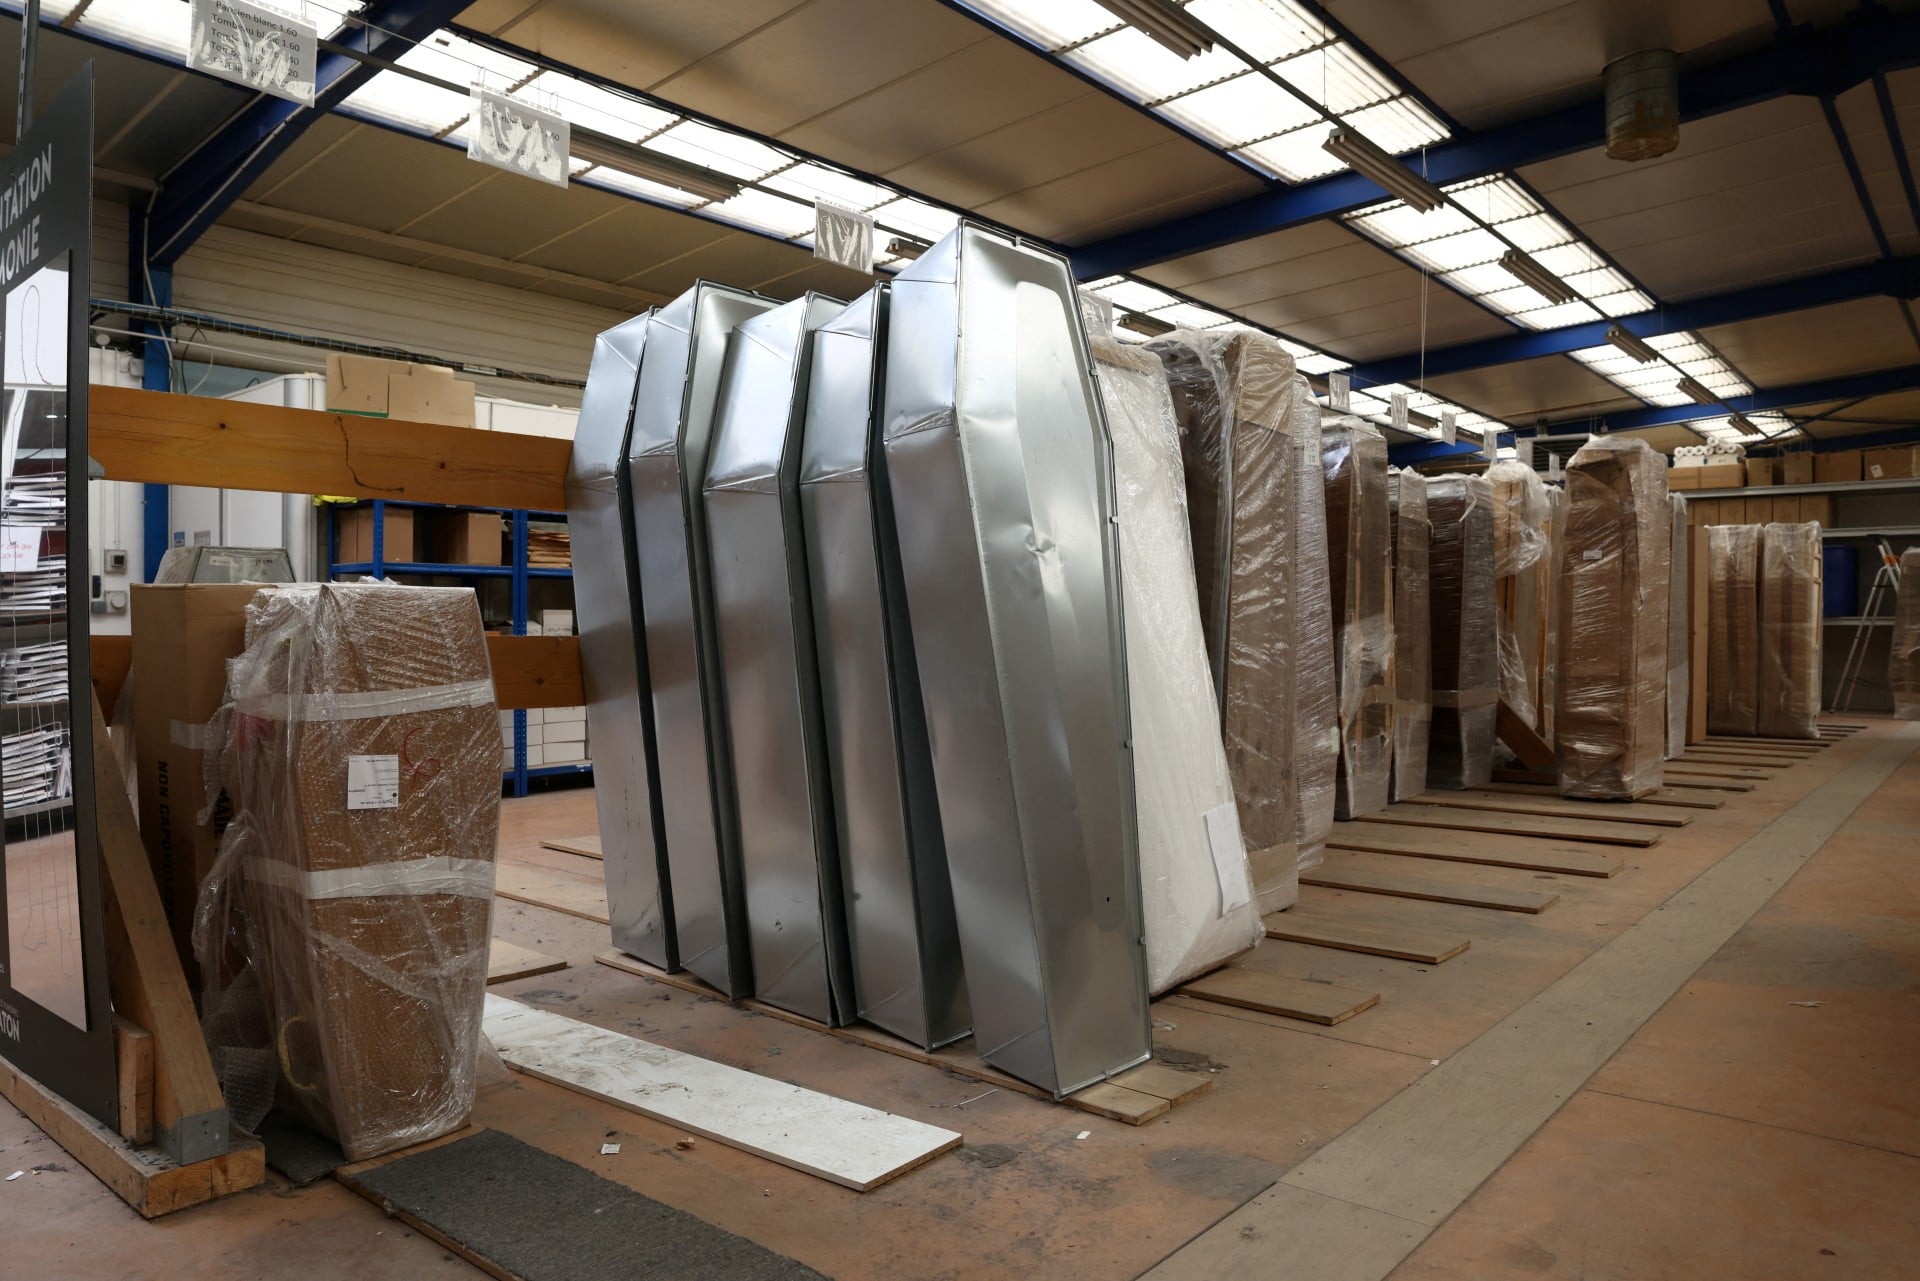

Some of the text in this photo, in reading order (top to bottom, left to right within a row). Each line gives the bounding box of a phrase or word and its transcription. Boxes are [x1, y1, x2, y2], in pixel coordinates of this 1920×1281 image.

[253, 14, 277, 30] blanc
[279, 24, 297, 37] 1.60
[256, 29, 279, 45] blnc
[282, 39, 300, 52] 1.60
[157, 761, 169, 798] NON
